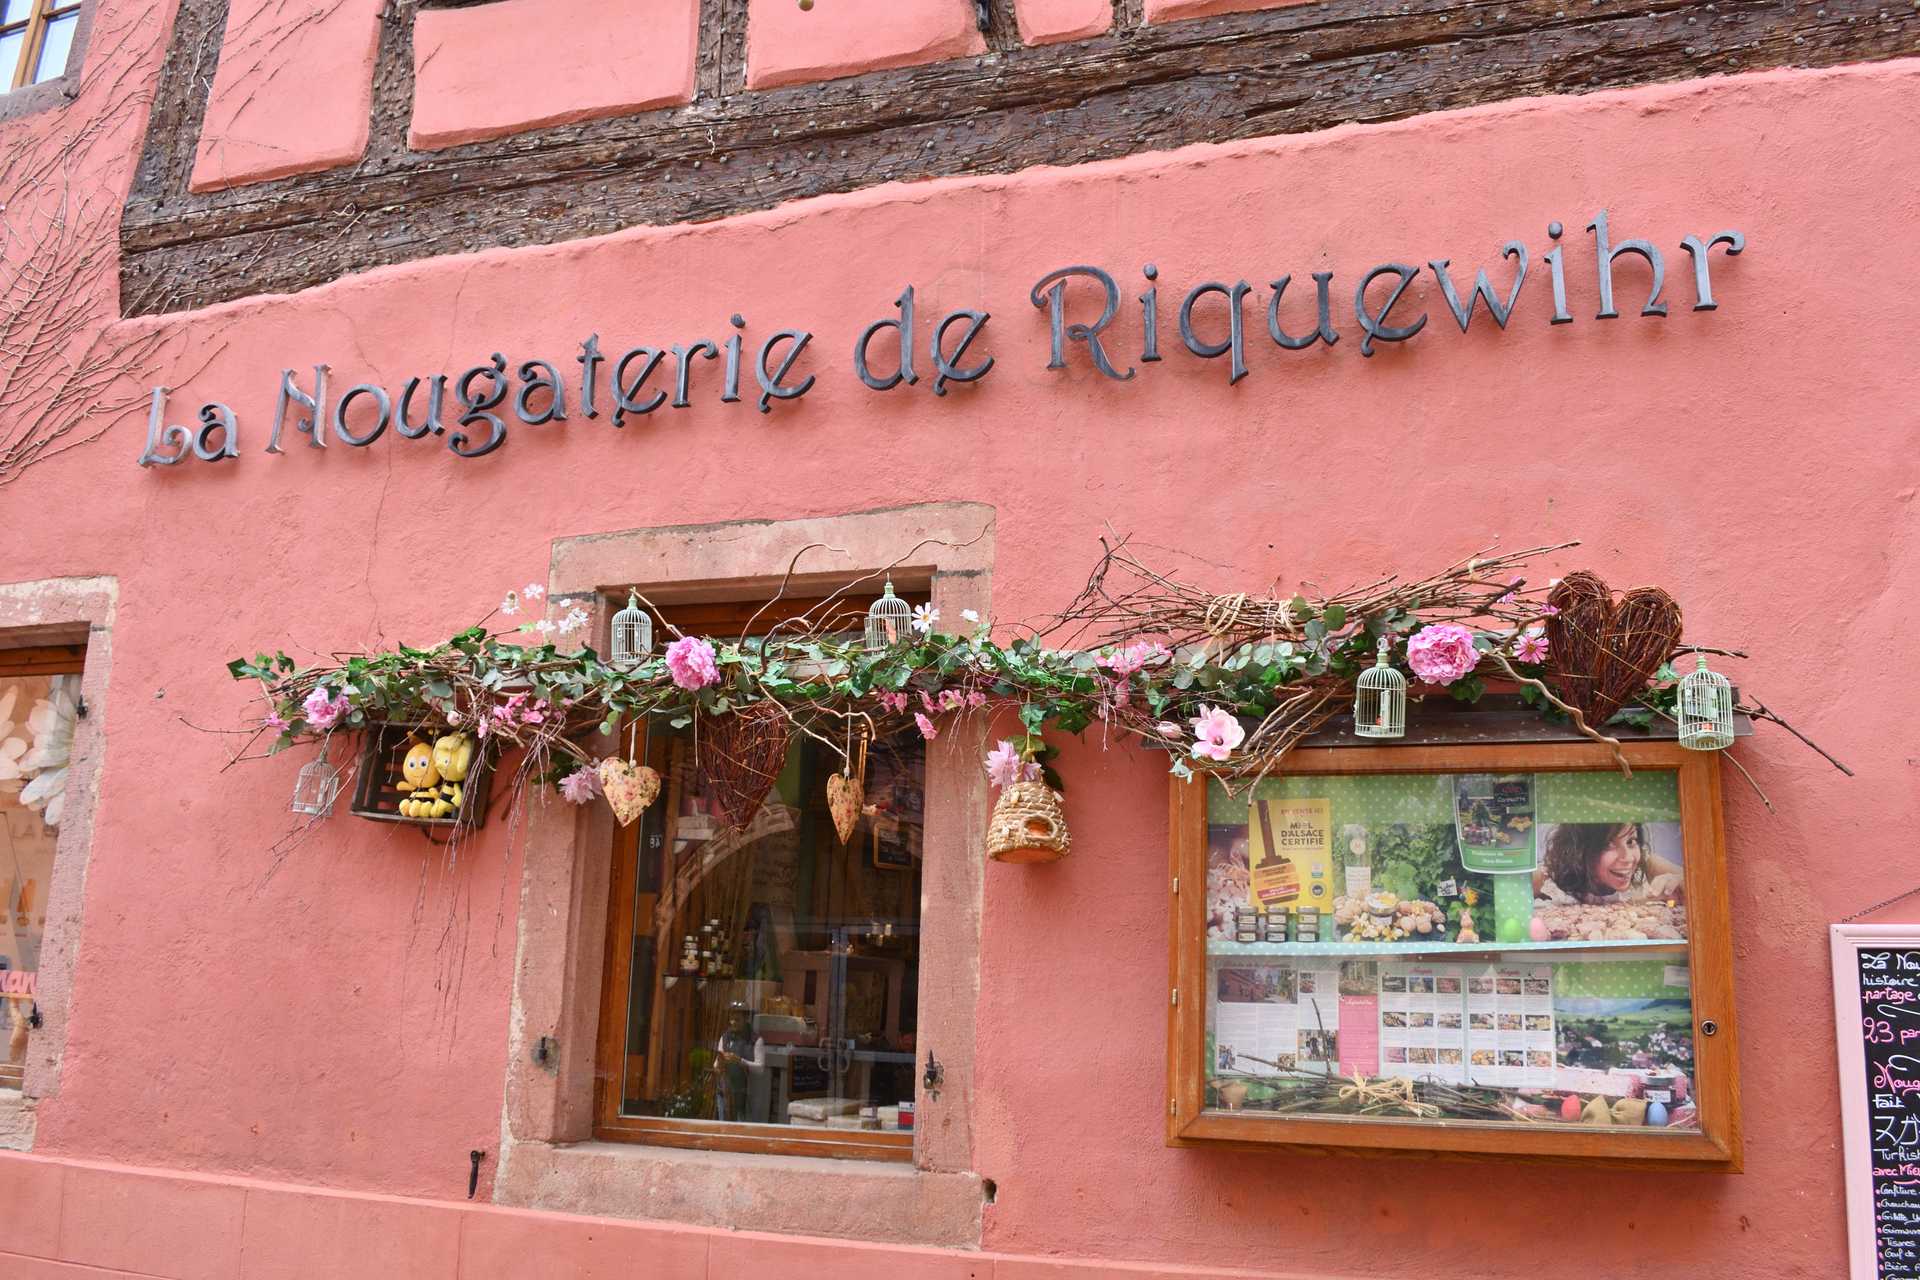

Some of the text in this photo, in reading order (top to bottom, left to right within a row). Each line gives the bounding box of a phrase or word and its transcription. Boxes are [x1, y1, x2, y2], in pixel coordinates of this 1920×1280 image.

[138, 208, 1746, 468] La Nougaterie de Riquewihr
[1861, 952, 1890, 969] La
[1863, 973, 1918, 986] histoire
[1862, 987, 1916, 1004] partage
[1864, 1017, 1894, 1043] 23
